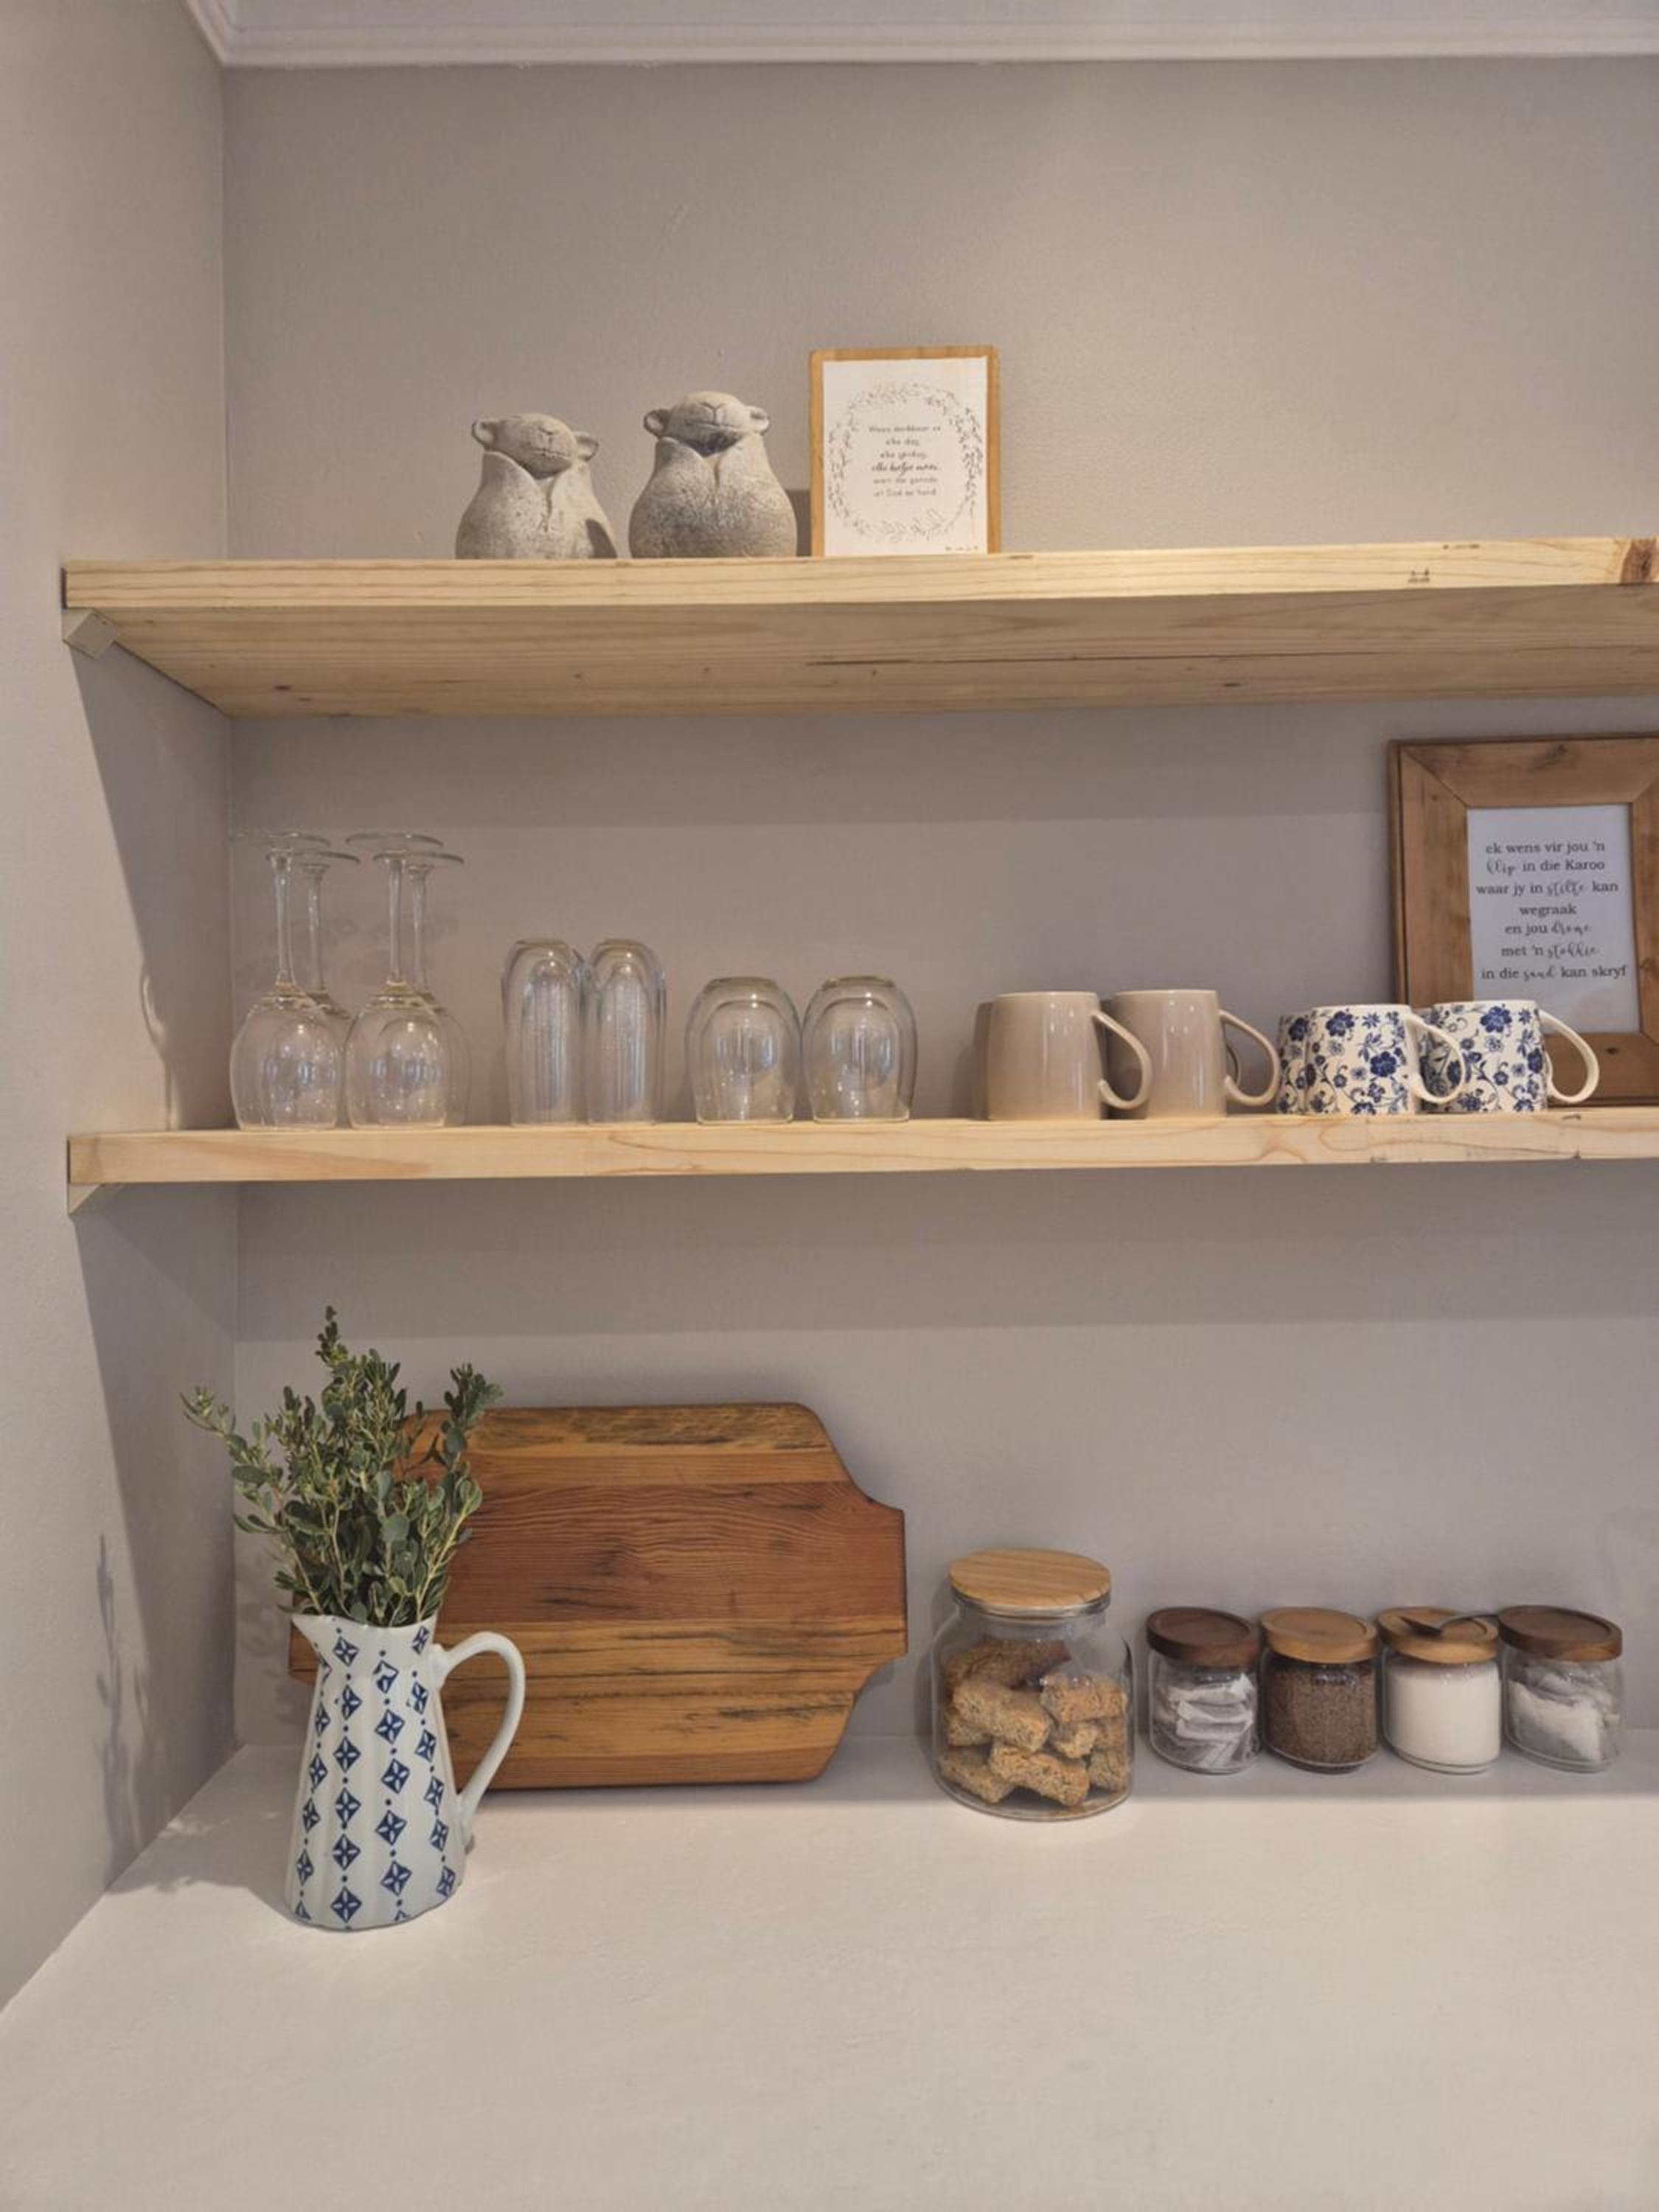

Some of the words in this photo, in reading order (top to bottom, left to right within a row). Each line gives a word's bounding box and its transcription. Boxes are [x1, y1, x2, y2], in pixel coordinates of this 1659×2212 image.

[1486, 842, 1502, 854] ek
[1506, 844, 1540, 854] wens
[1544, 842, 1563, 853] vir
[1566, 842, 1589, 855] jou
[1522, 860, 1536, 872] in
[1540, 860, 1561, 872] die
[1565, 859, 1605, 871] Karoo
[1475, 884, 1510, 894] waar
[1512, 882, 1526, 897] jy
[1529, 882, 1543, 894] in
[1592, 880, 1619, 892] kan
[1519, 903, 1578, 917] wegraak
[1504, 925, 1522, 934] en
[1525, 922, 1548, 936] jou
[1500, 945, 1528, 956] met
[1481, 968, 1495, 979] in
[1498, 967, 1520, 979] die
[1523, 965, 1555, 981] sand
[1560, 967, 1587, 978] kan
[1591, 965, 1627, 980] skryf
